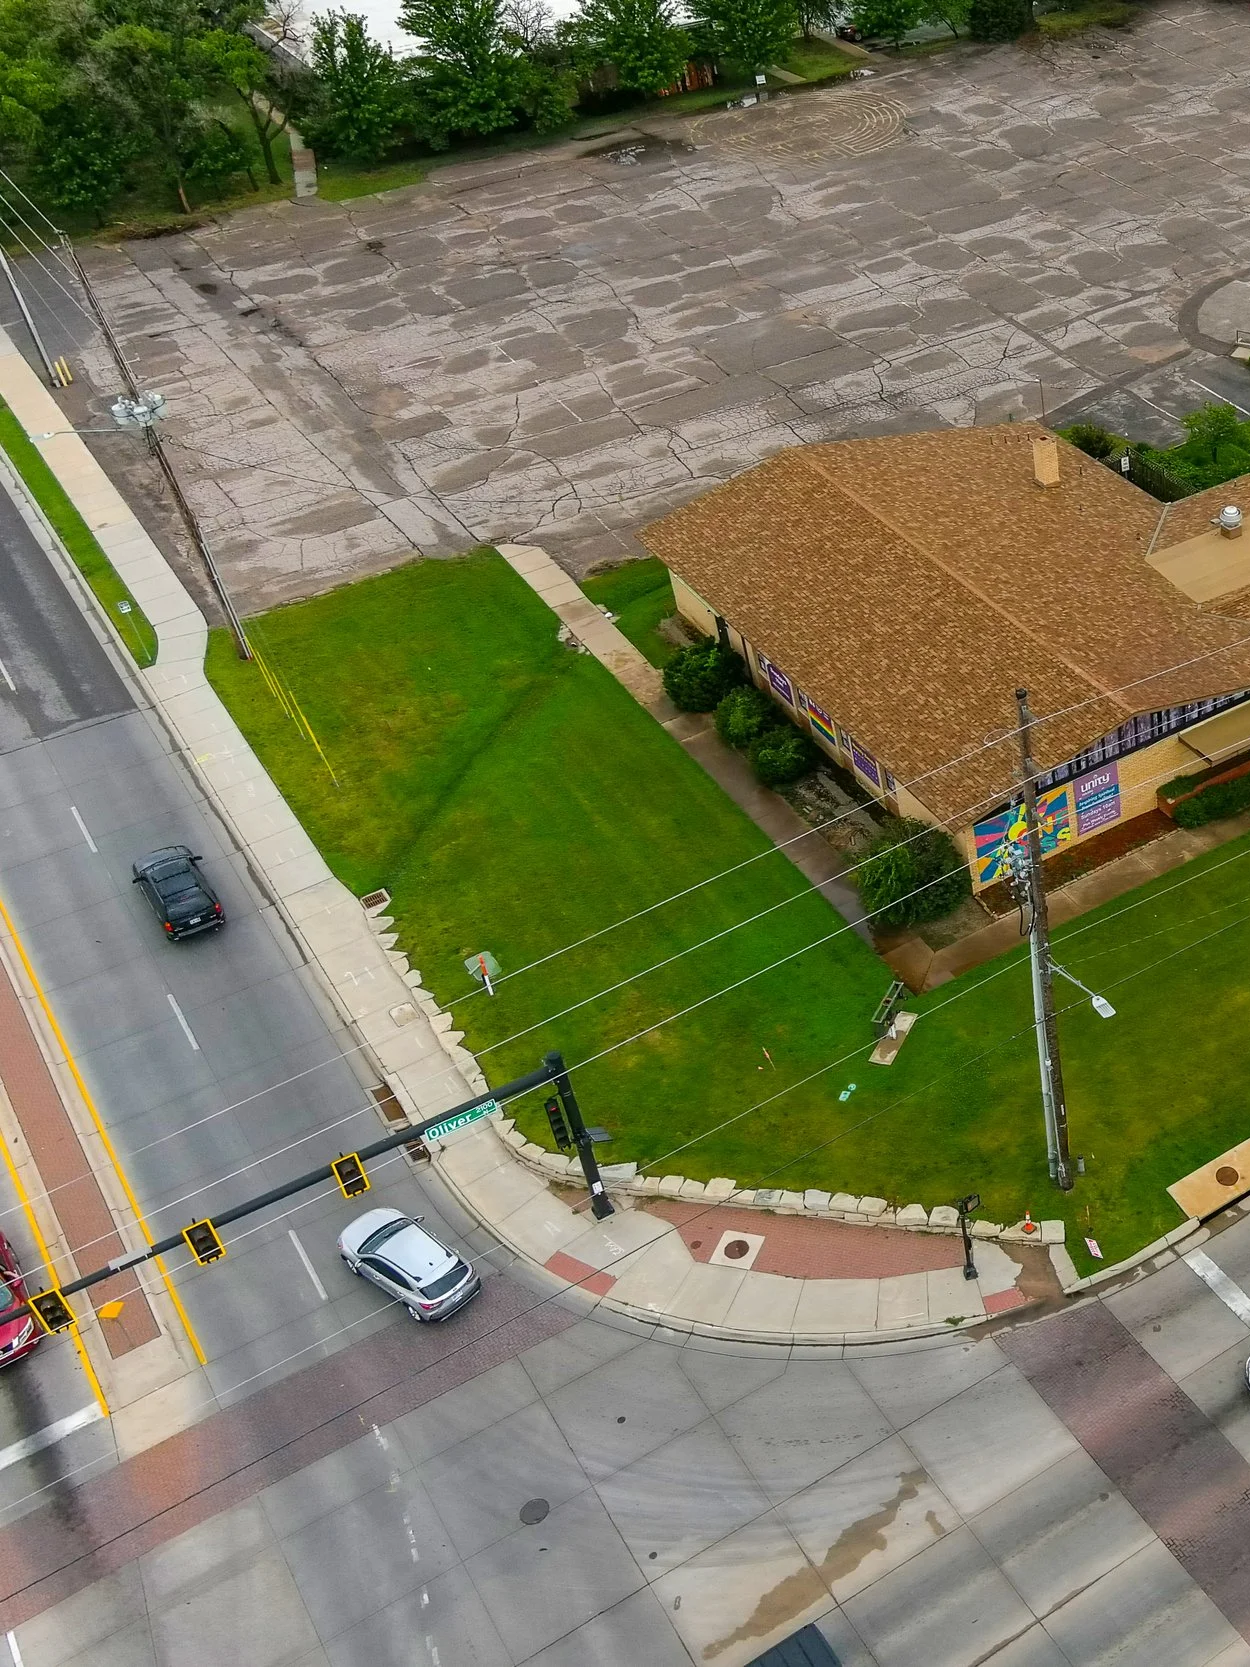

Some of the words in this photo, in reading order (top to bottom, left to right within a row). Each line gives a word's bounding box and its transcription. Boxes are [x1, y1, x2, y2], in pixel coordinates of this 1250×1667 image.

[1081, 773, 1110, 792] unity
[1081, 807, 1101, 820] Sundays
[429, 1114, 471, 1139] Oliver
[475, 1101, 493, 1113] 2100
